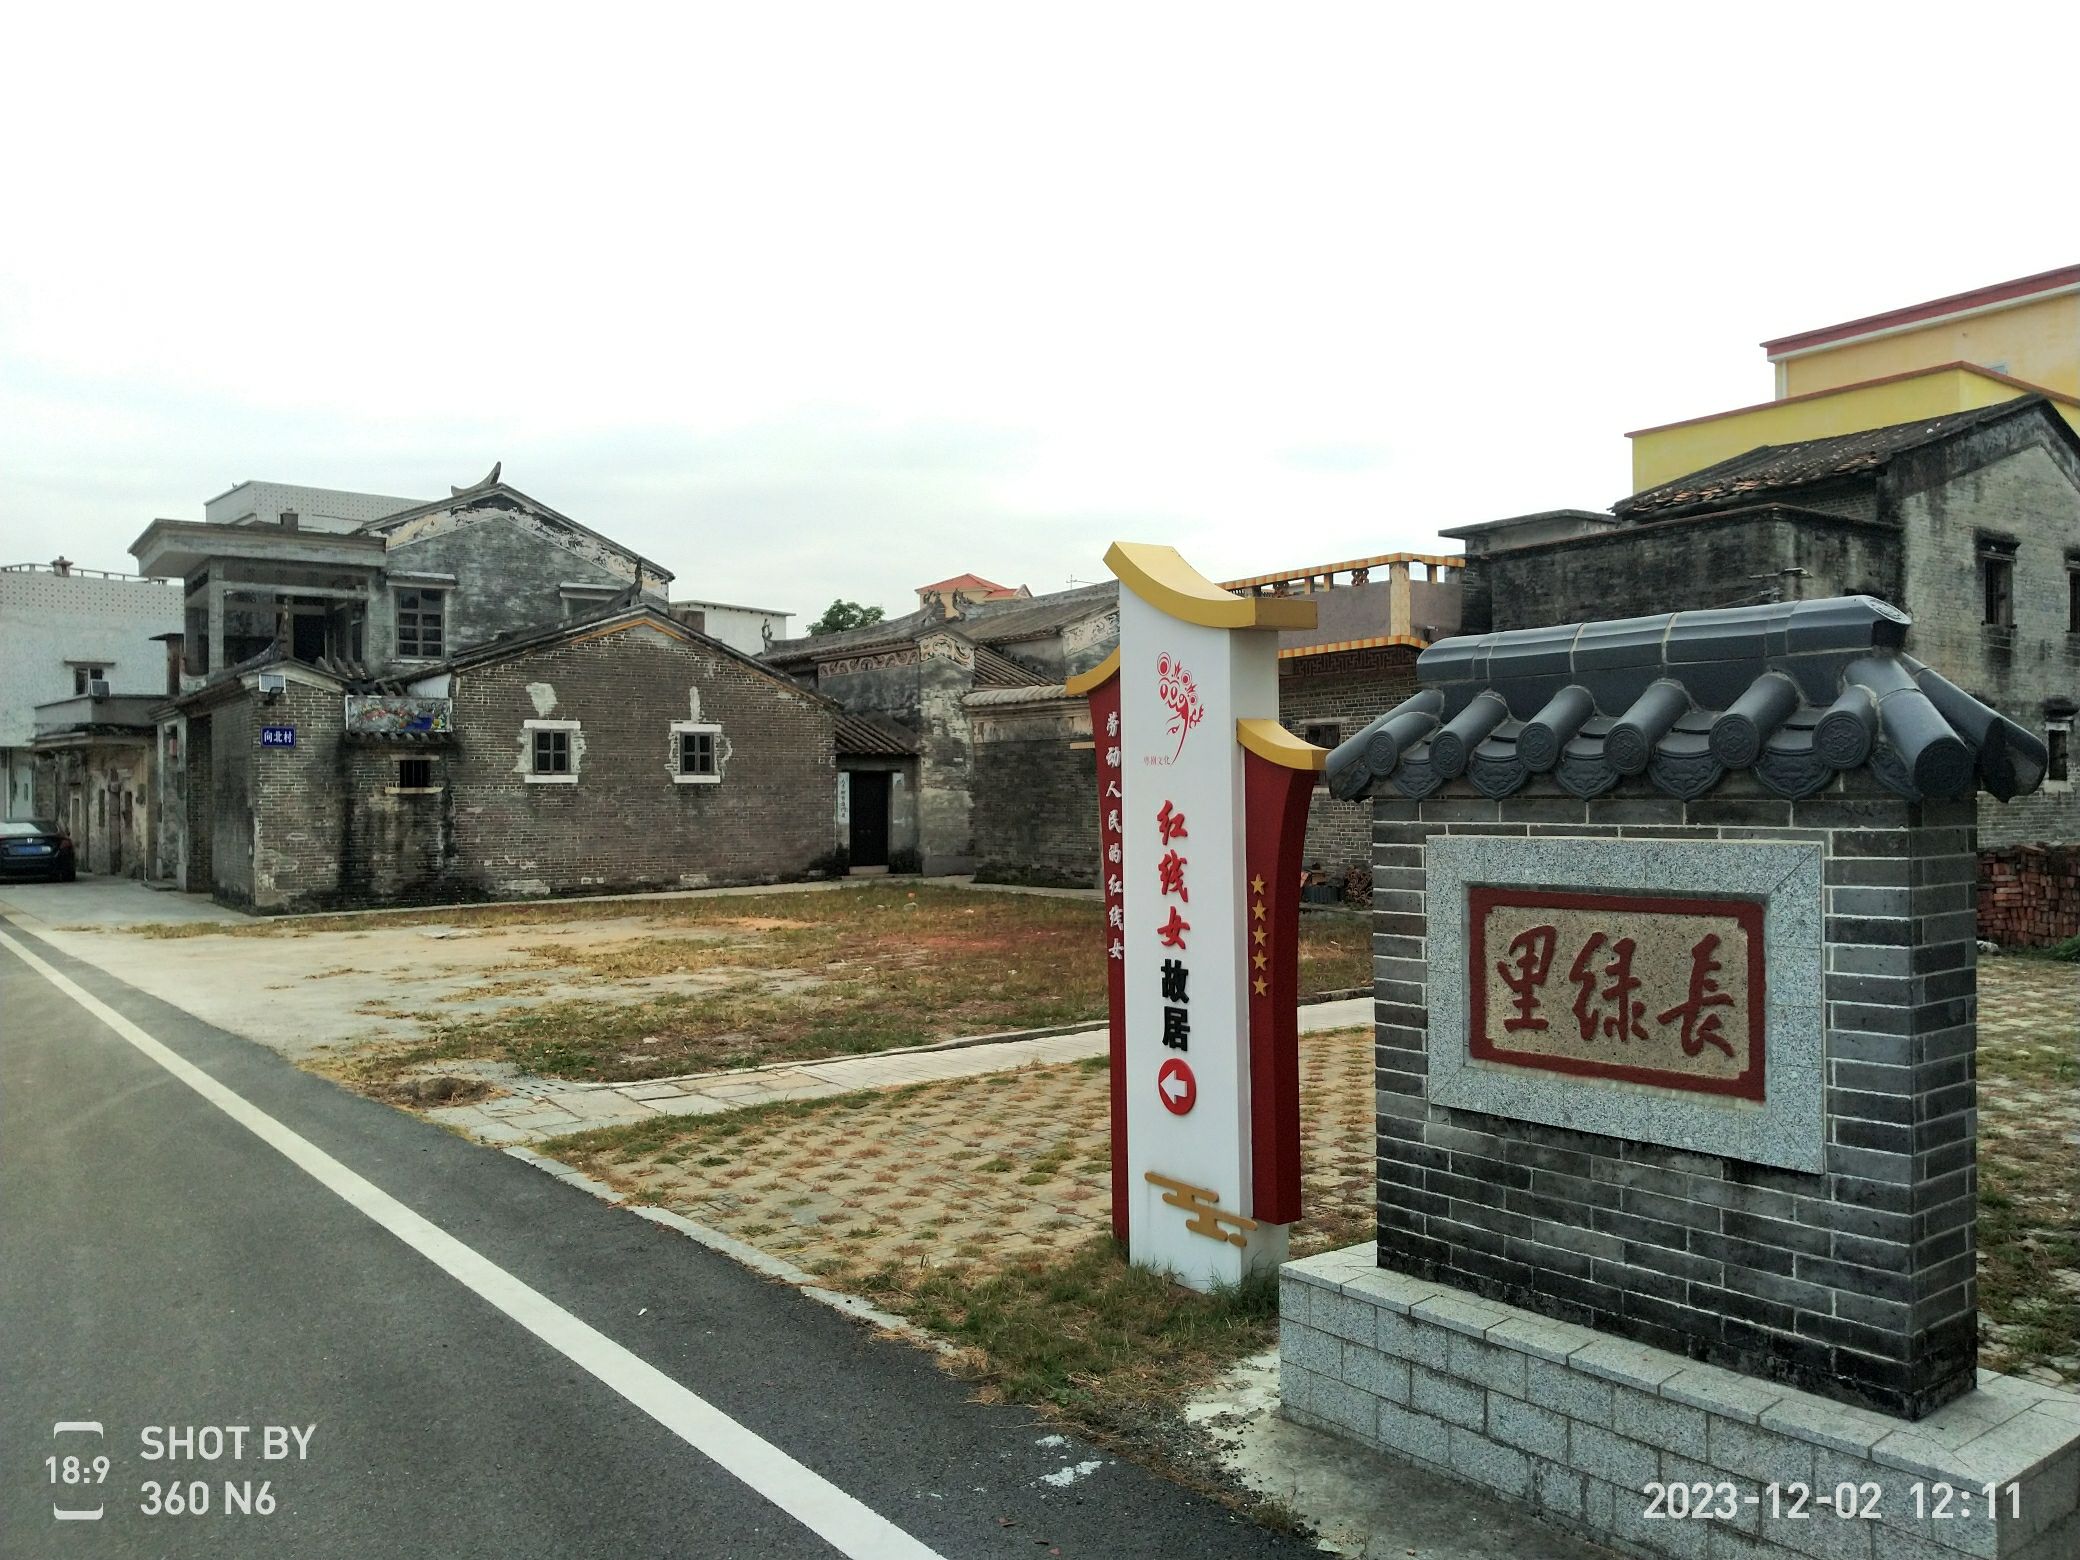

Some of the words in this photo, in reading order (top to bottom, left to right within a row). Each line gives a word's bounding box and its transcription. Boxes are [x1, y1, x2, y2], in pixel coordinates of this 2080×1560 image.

[264, 730, 292, 743] 向北村
[1105, 711, 1124, 960] 劳动人民的红线女
[1156, 799, 1190, 1053] 红线女故居
